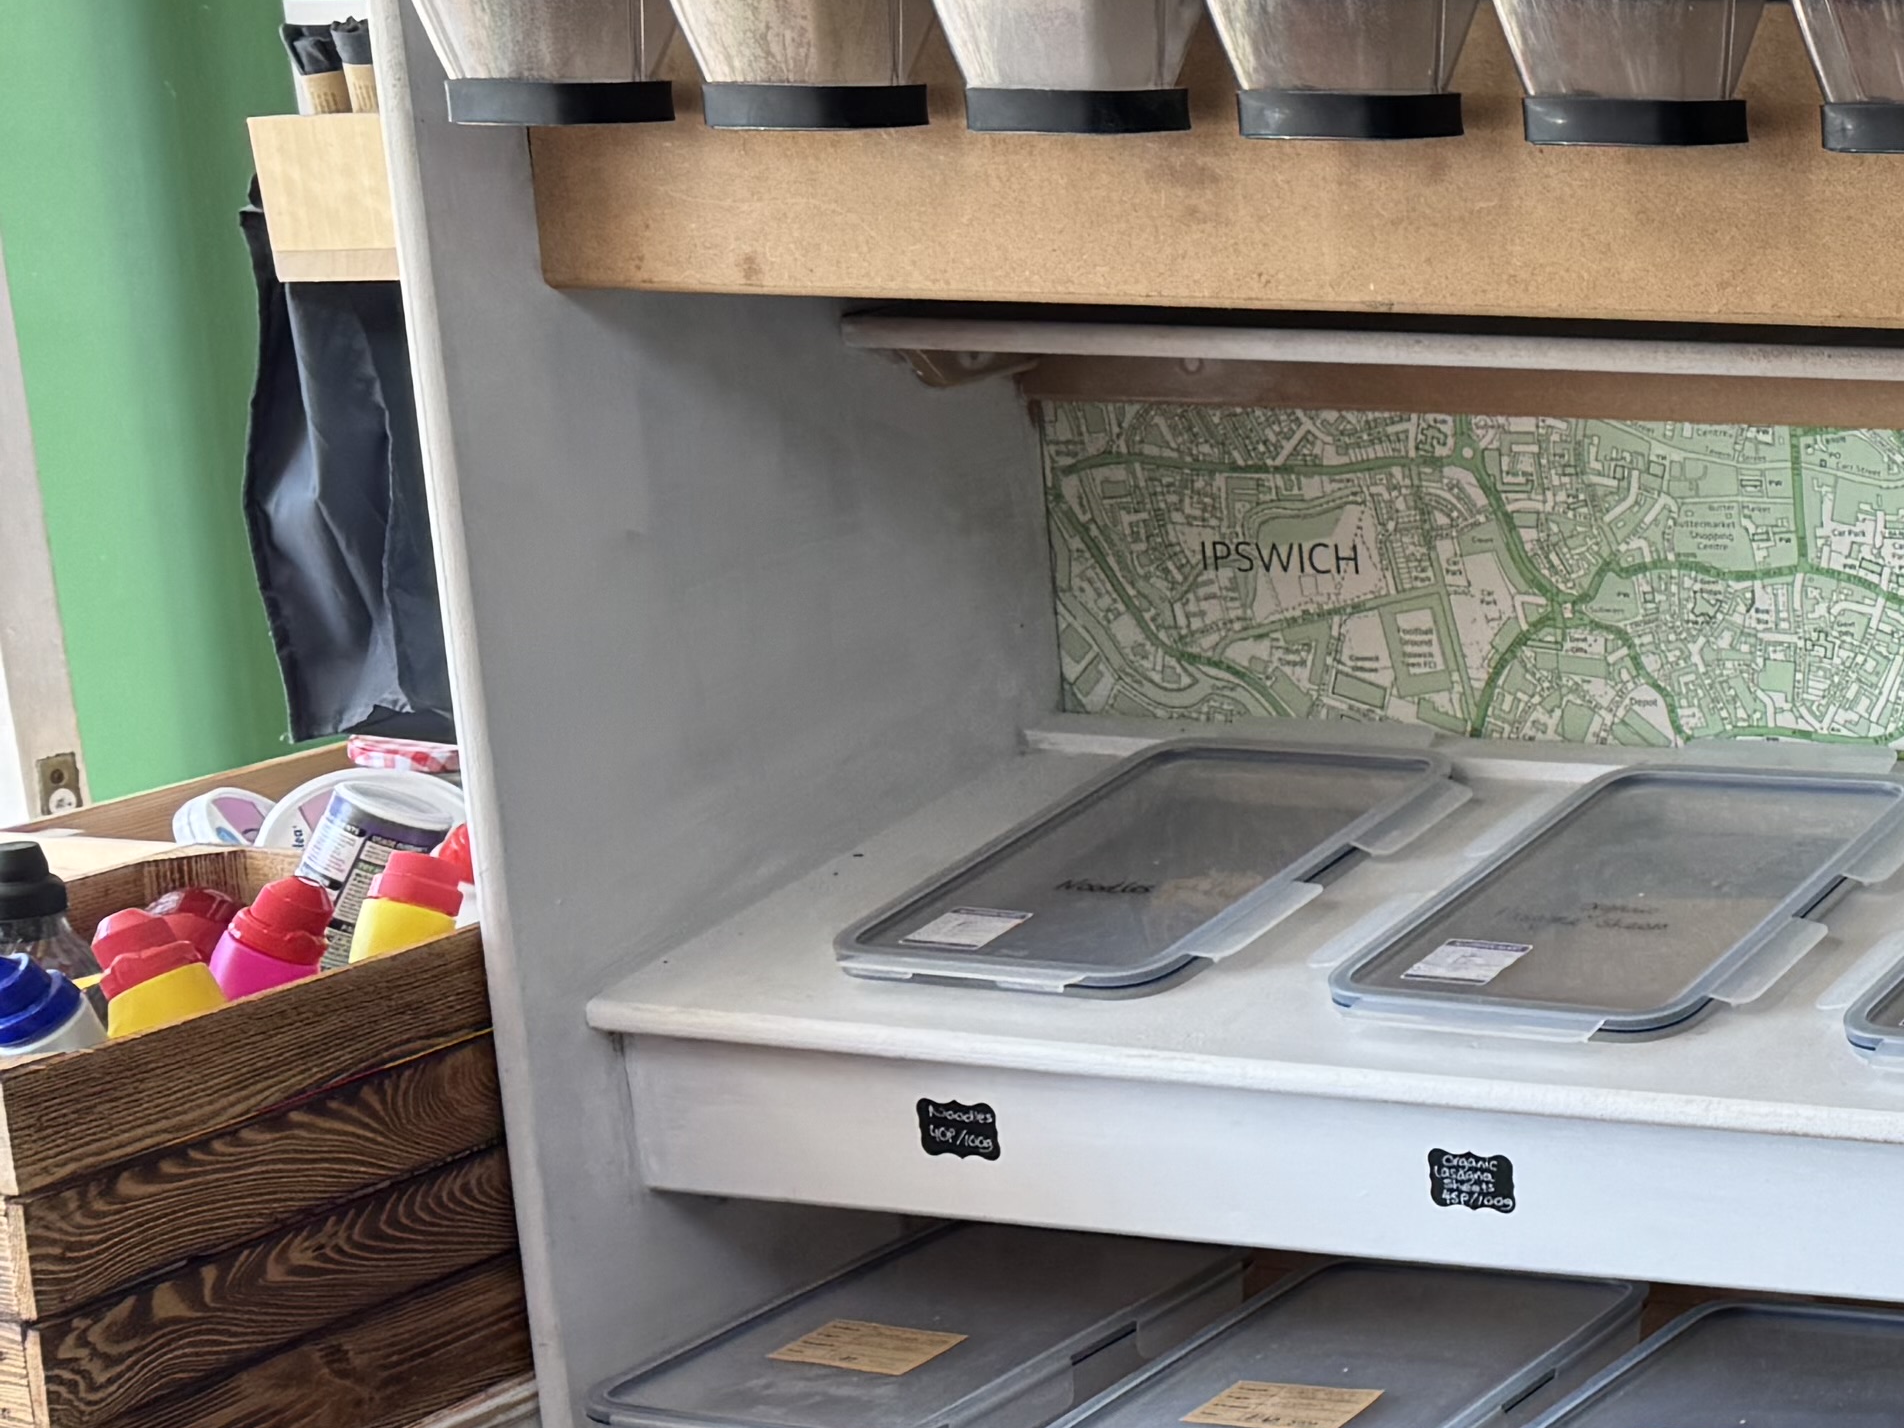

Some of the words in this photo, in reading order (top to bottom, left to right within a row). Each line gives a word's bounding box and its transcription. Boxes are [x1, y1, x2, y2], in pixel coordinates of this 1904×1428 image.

[1200, 538, 1361, 576] IPSWICH
[1054, 877, 1155, 896] Noodles
[928, 1104, 993, 1124] Noodles
[1441, 1154, 1498, 1172] Organic
